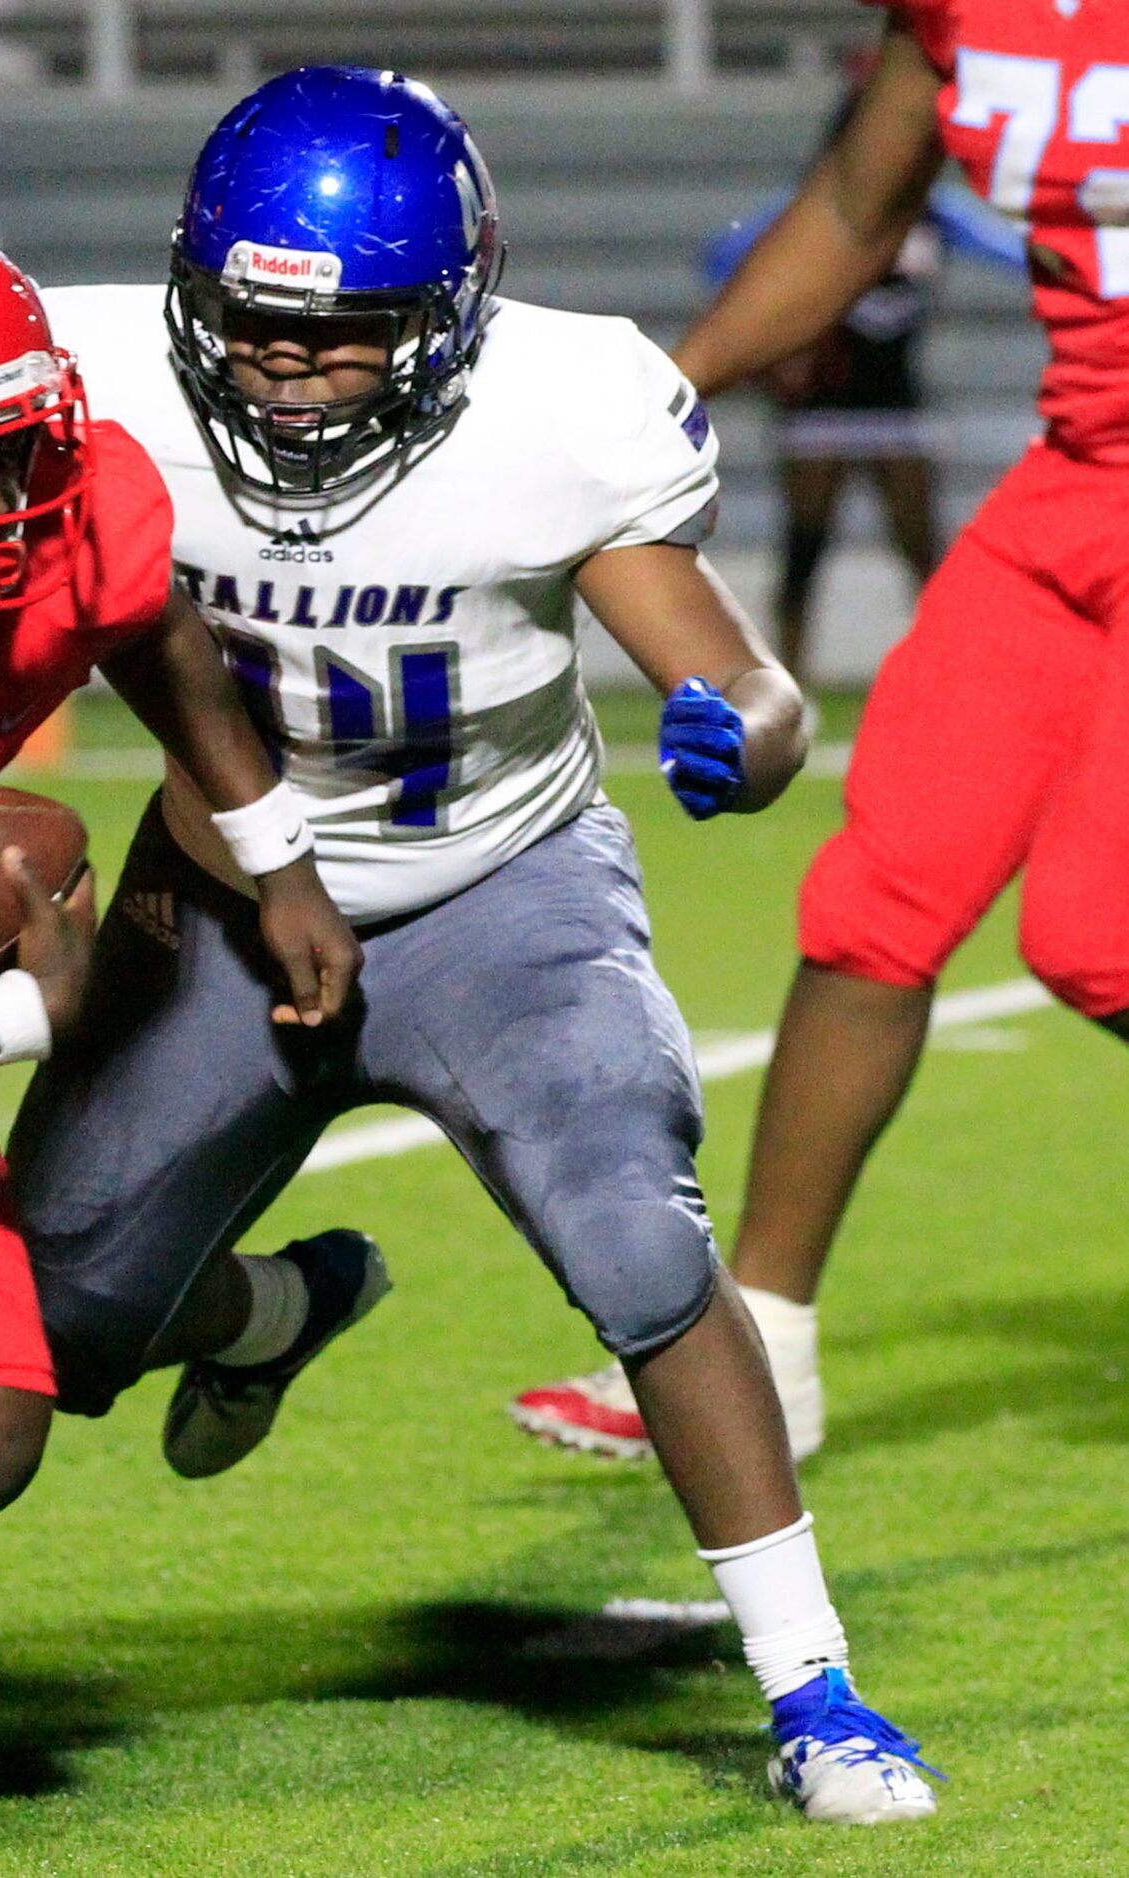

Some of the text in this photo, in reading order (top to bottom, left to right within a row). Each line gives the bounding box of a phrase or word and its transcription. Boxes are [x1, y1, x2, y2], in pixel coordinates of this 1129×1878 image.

[252, 252, 311, 276] Riddell
[259, 545, 334, 564] adidas
[173, 559, 470, 629] TALLIONS
